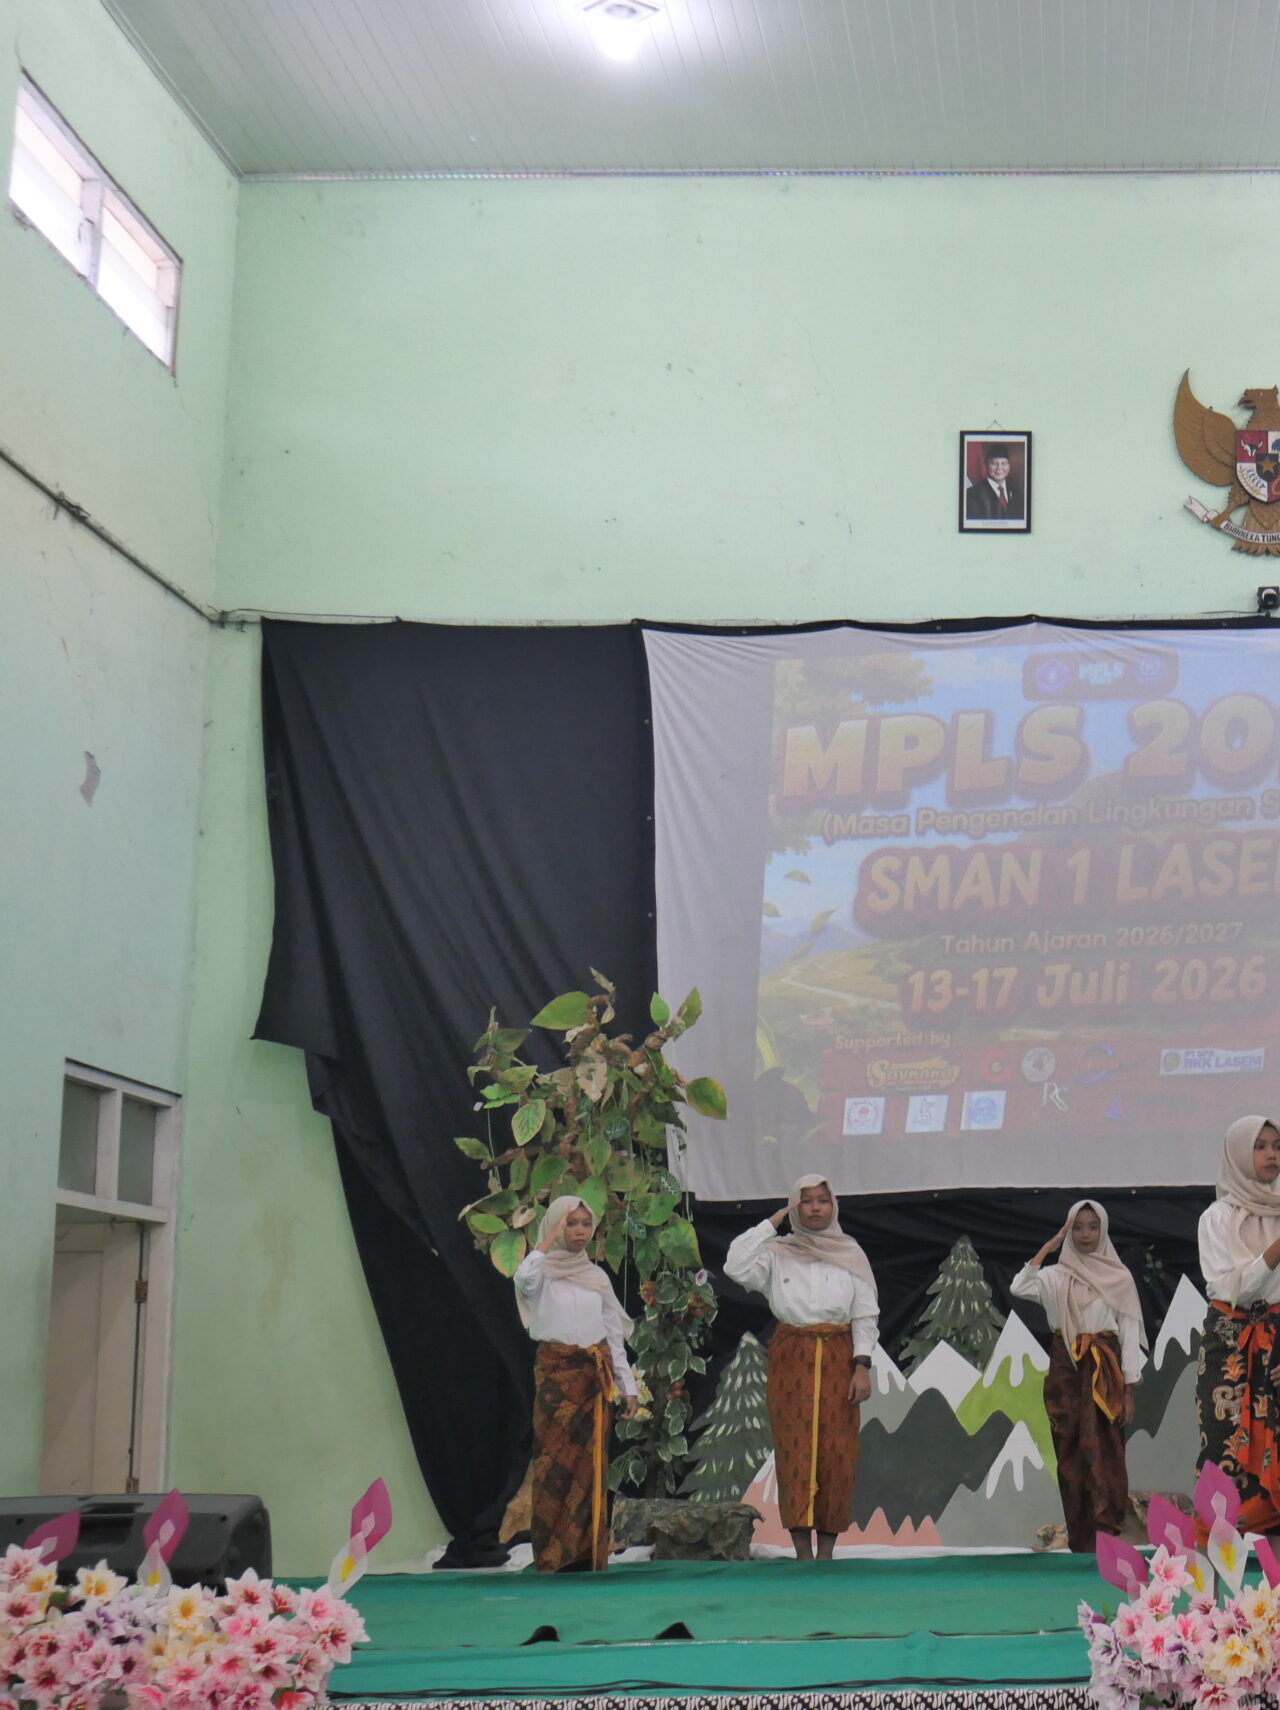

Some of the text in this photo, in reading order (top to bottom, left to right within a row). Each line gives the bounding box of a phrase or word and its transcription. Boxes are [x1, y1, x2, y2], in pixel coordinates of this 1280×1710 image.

[1223, 522, 1260, 542] BHINNEKA
[780, 703, 1087, 800] MPLS
[822, 812, 908, 843] (Masa
[916, 802, 1078, 838] Pengenalan
[1087, 797, 1254, 828] Lingkungan
[865, 849, 1043, 912] SMAN
[1066, 848, 1091, 905] 1
[941, 922, 1243, 956] Tahun Ajaran 2026/2027
[907, 956, 1266, 1013] 13-17 Juli 2026
[835, 1030, 951, 1054] Supported by
[1183, 1056, 1263, 1069] BKK LASEM
